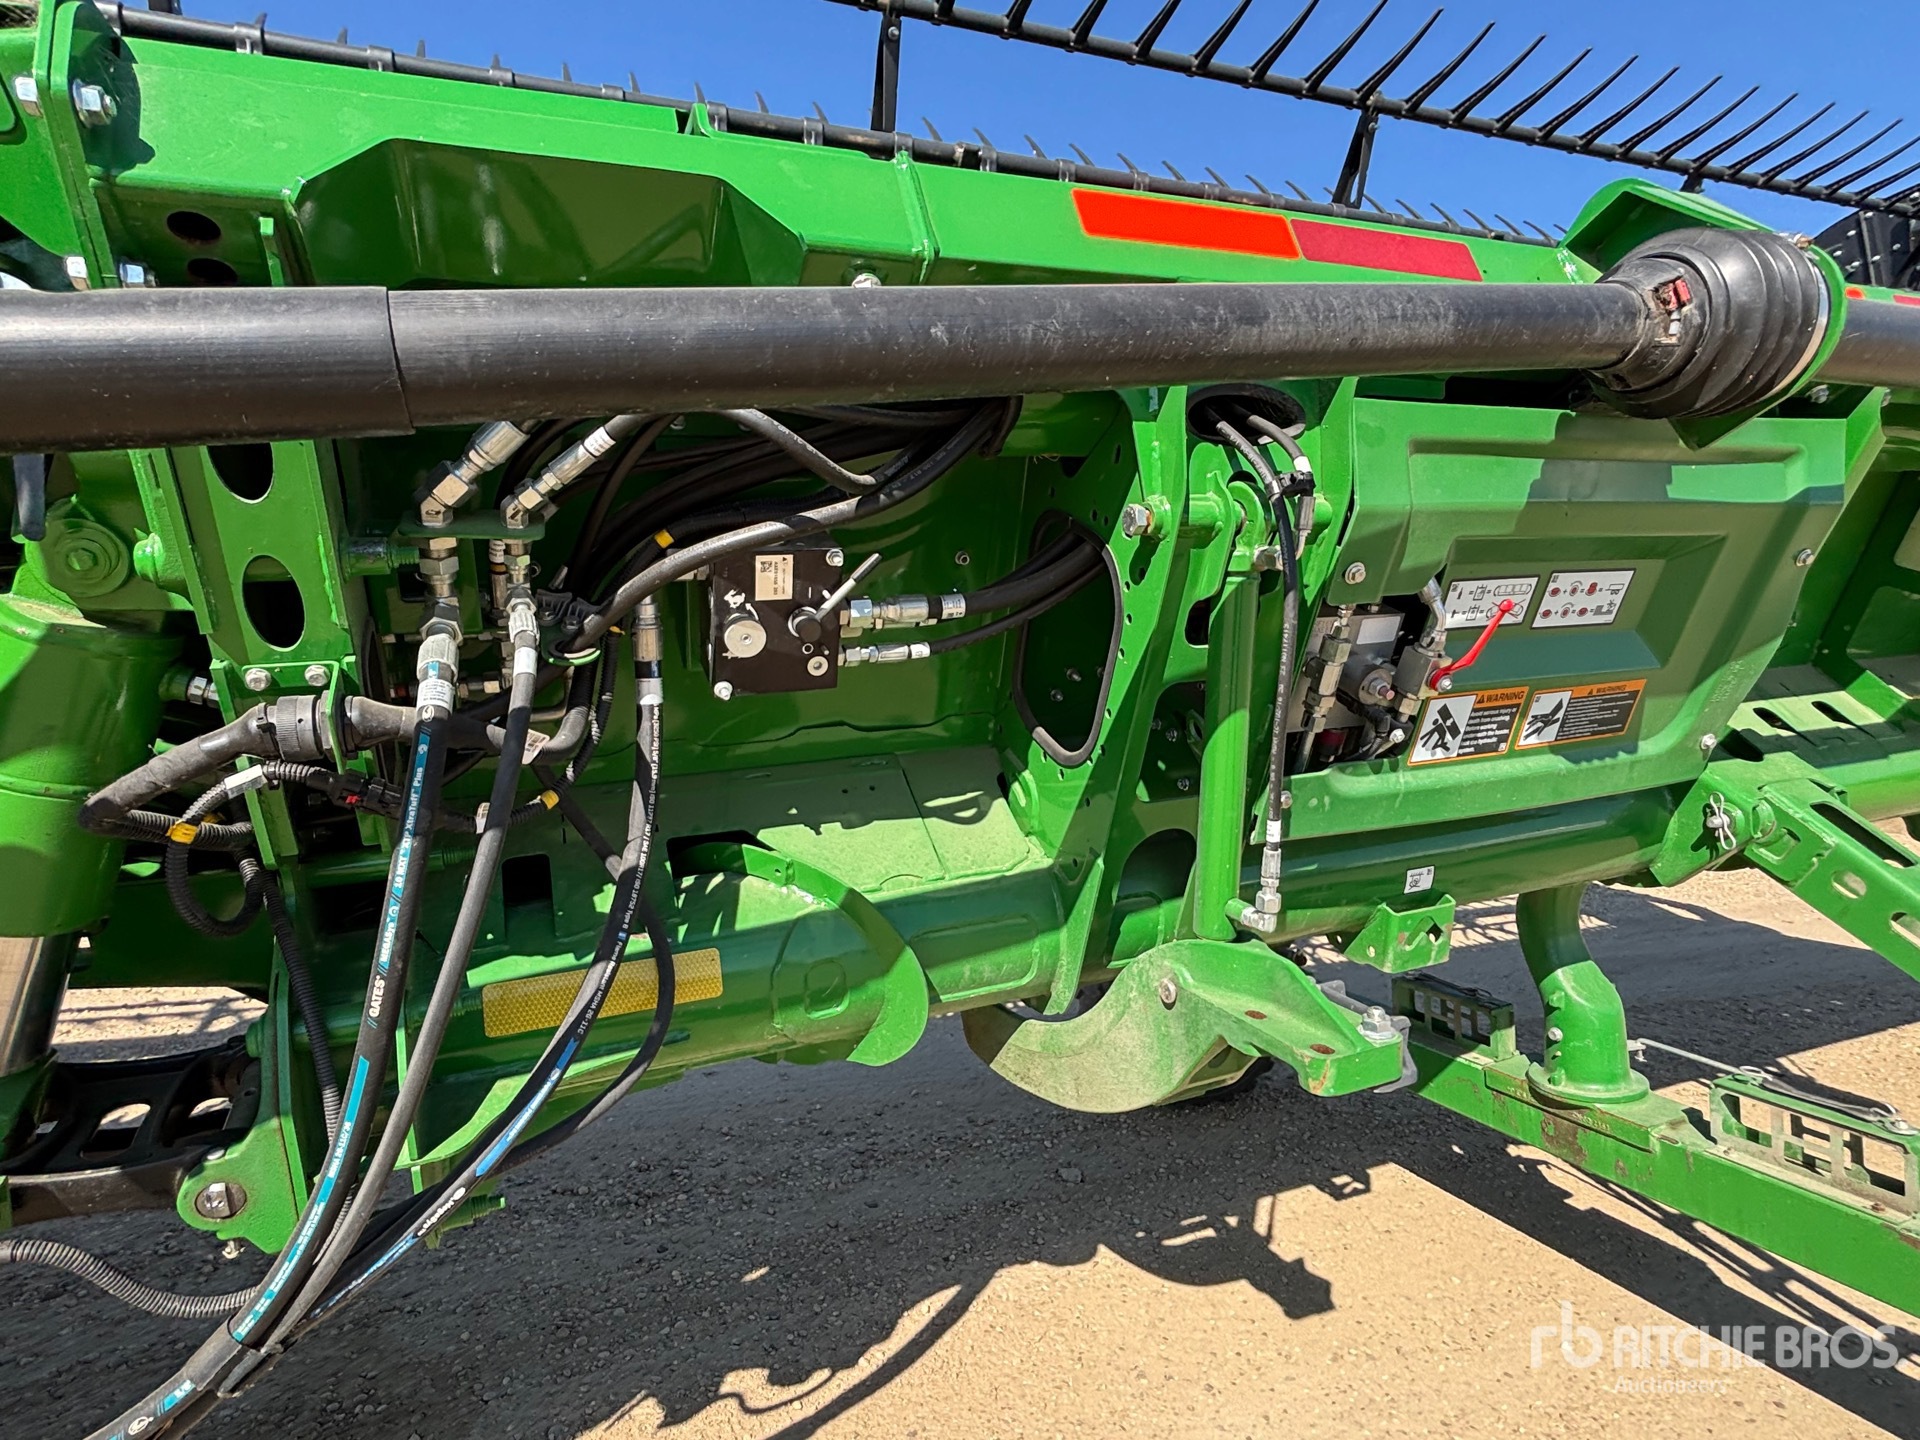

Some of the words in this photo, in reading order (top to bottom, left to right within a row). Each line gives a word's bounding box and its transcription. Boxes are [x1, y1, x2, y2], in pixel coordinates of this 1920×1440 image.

[1486, 690, 1525, 703] WARNING
[393, 875, 404, 888] 10
[412, 766, 423, 787] Plus
[641, 839, 650, 852] SAE
[627, 888, 639, 909] 18752
[622, 908, 633, 923] Type
[610, 940, 623, 960] Flame
[597, 959, 617, 991] Resistant
[588, 989, 603, 1009] MSHA
[576, 1008, 595, 1035] 2G-11C
